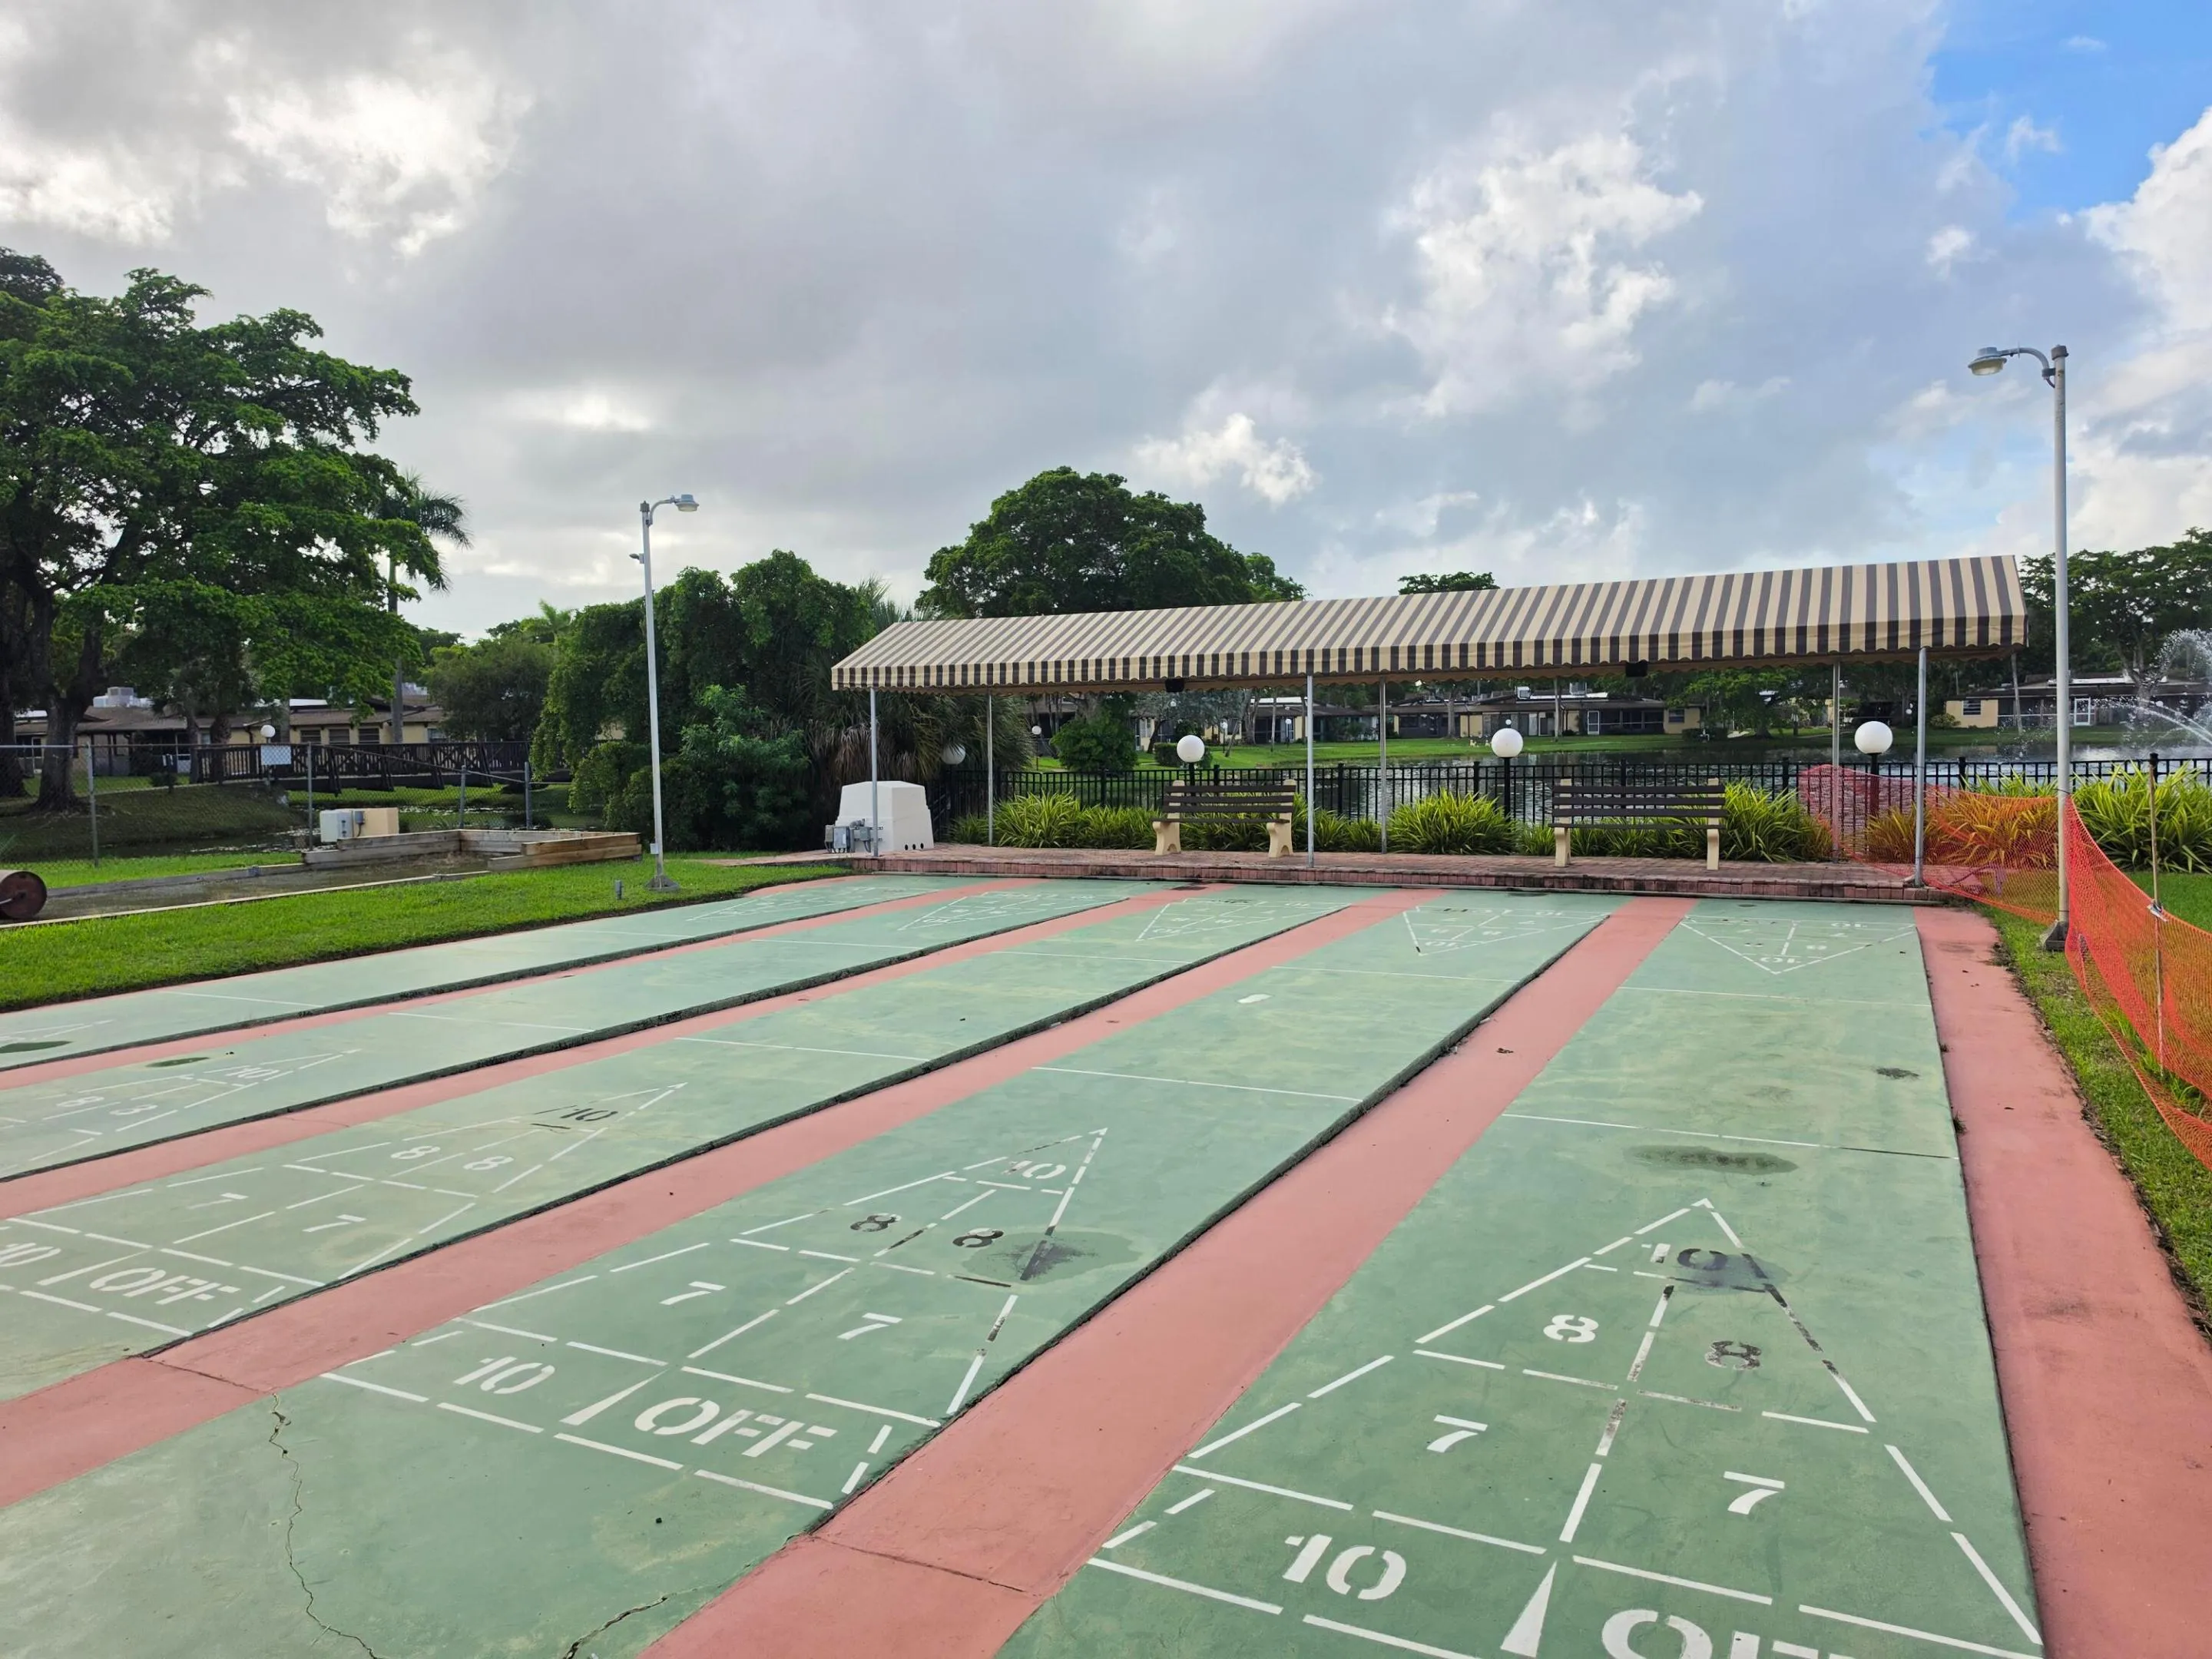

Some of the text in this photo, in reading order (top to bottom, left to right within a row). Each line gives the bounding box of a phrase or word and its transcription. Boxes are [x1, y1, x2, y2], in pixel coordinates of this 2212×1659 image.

[224, 1065, 280, 1078] 10
[55, 1095, 104, 1108] 8
[560, 1108, 618, 1121] 10
[390, 1145, 441, 1160] 8
[462, 1156, 514, 1171] 8
[1001, 1161, 1066, 1179] 10
[187, 1192, 248, 1210] 7
[303, 1214, 366, 1232] 7
[849, 1213, 902, 1232] 8
[952, 1228, 1004, 1248] 8
[89, 1267, 241, 1306] OFF
[659, 1281, 727, 1306] 7
[837, 1313, 903, 1340] 7
[1543, 1314, 1599, 1343] 8
[1704, 1340, 1762, 1370] 8
[454, 1356, 555, 1395] 10
[634, 1396, 838, 1458] OFF
[1426, 1414, 1488, 1453] 7
[1723, 1471, 1786, 1515] 7
[1283, 1533, 1407, 1601] 10
